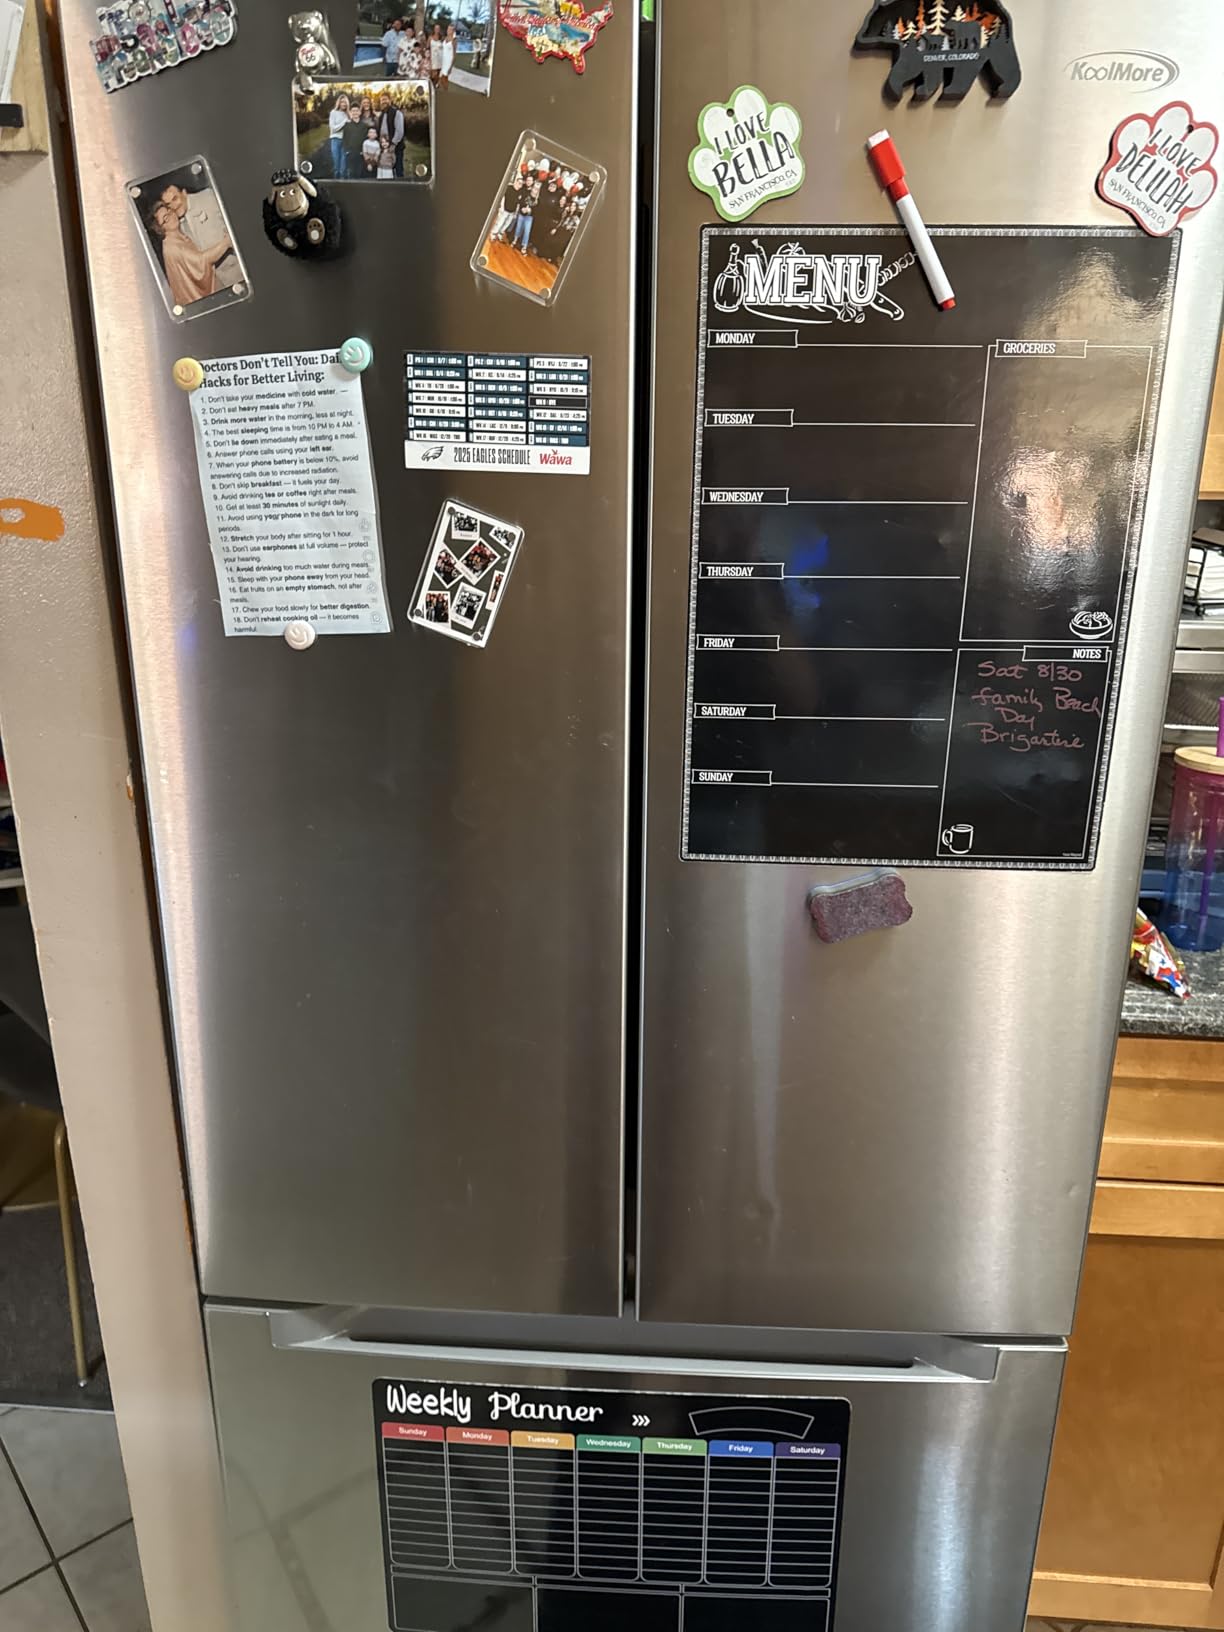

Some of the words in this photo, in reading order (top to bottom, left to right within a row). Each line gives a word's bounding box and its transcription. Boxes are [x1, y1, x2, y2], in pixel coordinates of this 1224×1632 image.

[1070, 61, 1164, 82] KoolMore
[714, 137, 722, 154] I
[725, 112, 769, 150] LOVE
[1149, 128, 1162, 144] I
[1157, 135, 1202, 177] LOVE
[712, 131, 795, 197] BELLA
[1109, 178, 1124, 192] SAN
[1116, 142, 1194, 214] DELILAH
[729, 195, 744, 208] SAN
[785, 169, 797, 178] CA
[744, 254, 882, 306] MENU
[715, 333, 755, 344] MONDAY
[1003, 343, 1056, 354] GROCERIES
[239, 358, 269, 369] Don't
[270, 357, 292, 367] Tell
[294, 355, 318, 366] You:
[233, 376, 249, 385] for
[251, 374, 285, 384] Better
[287, 372, 324, 384] Living:
[713, 413, 755, 424] TUESDAY
[453, 447, 471, 463] 2025
[472, 448, 496, 464] EAGLES
[497, 449, 531, 465] SCHEDULE
[539, 451, 573, 465] Wawa
[709, 491, 764, 502] WEDNESDAY
[706, 566, 754, 577] THURSDAY
[703, 638, 735, 648] FRIDAY
[1072, 649, 1102, 659] NOTES
[978, 661, 1028, 679] Sat
[701, 706, 747, 716] SATURDAY
[994, 707, 1035, 731] Day
[698, 772, 734, 782] SUNDAY
[386, 1384, 471, 1424] Weekly
[487, 1391, 604, 1423] Planner
[398, 1426, 428, 1437] Sunday
[461, 1431, 493, 1442] Monday
[526, 1434, 559, 1446] Tuesday
[585, 1438, 631, 1449] Wednesday
[656, 1441, 693, 1451] Thursday
[728, 1444, 754, 1454] Friday
[789, 1446, 826, 1455] Saturday
